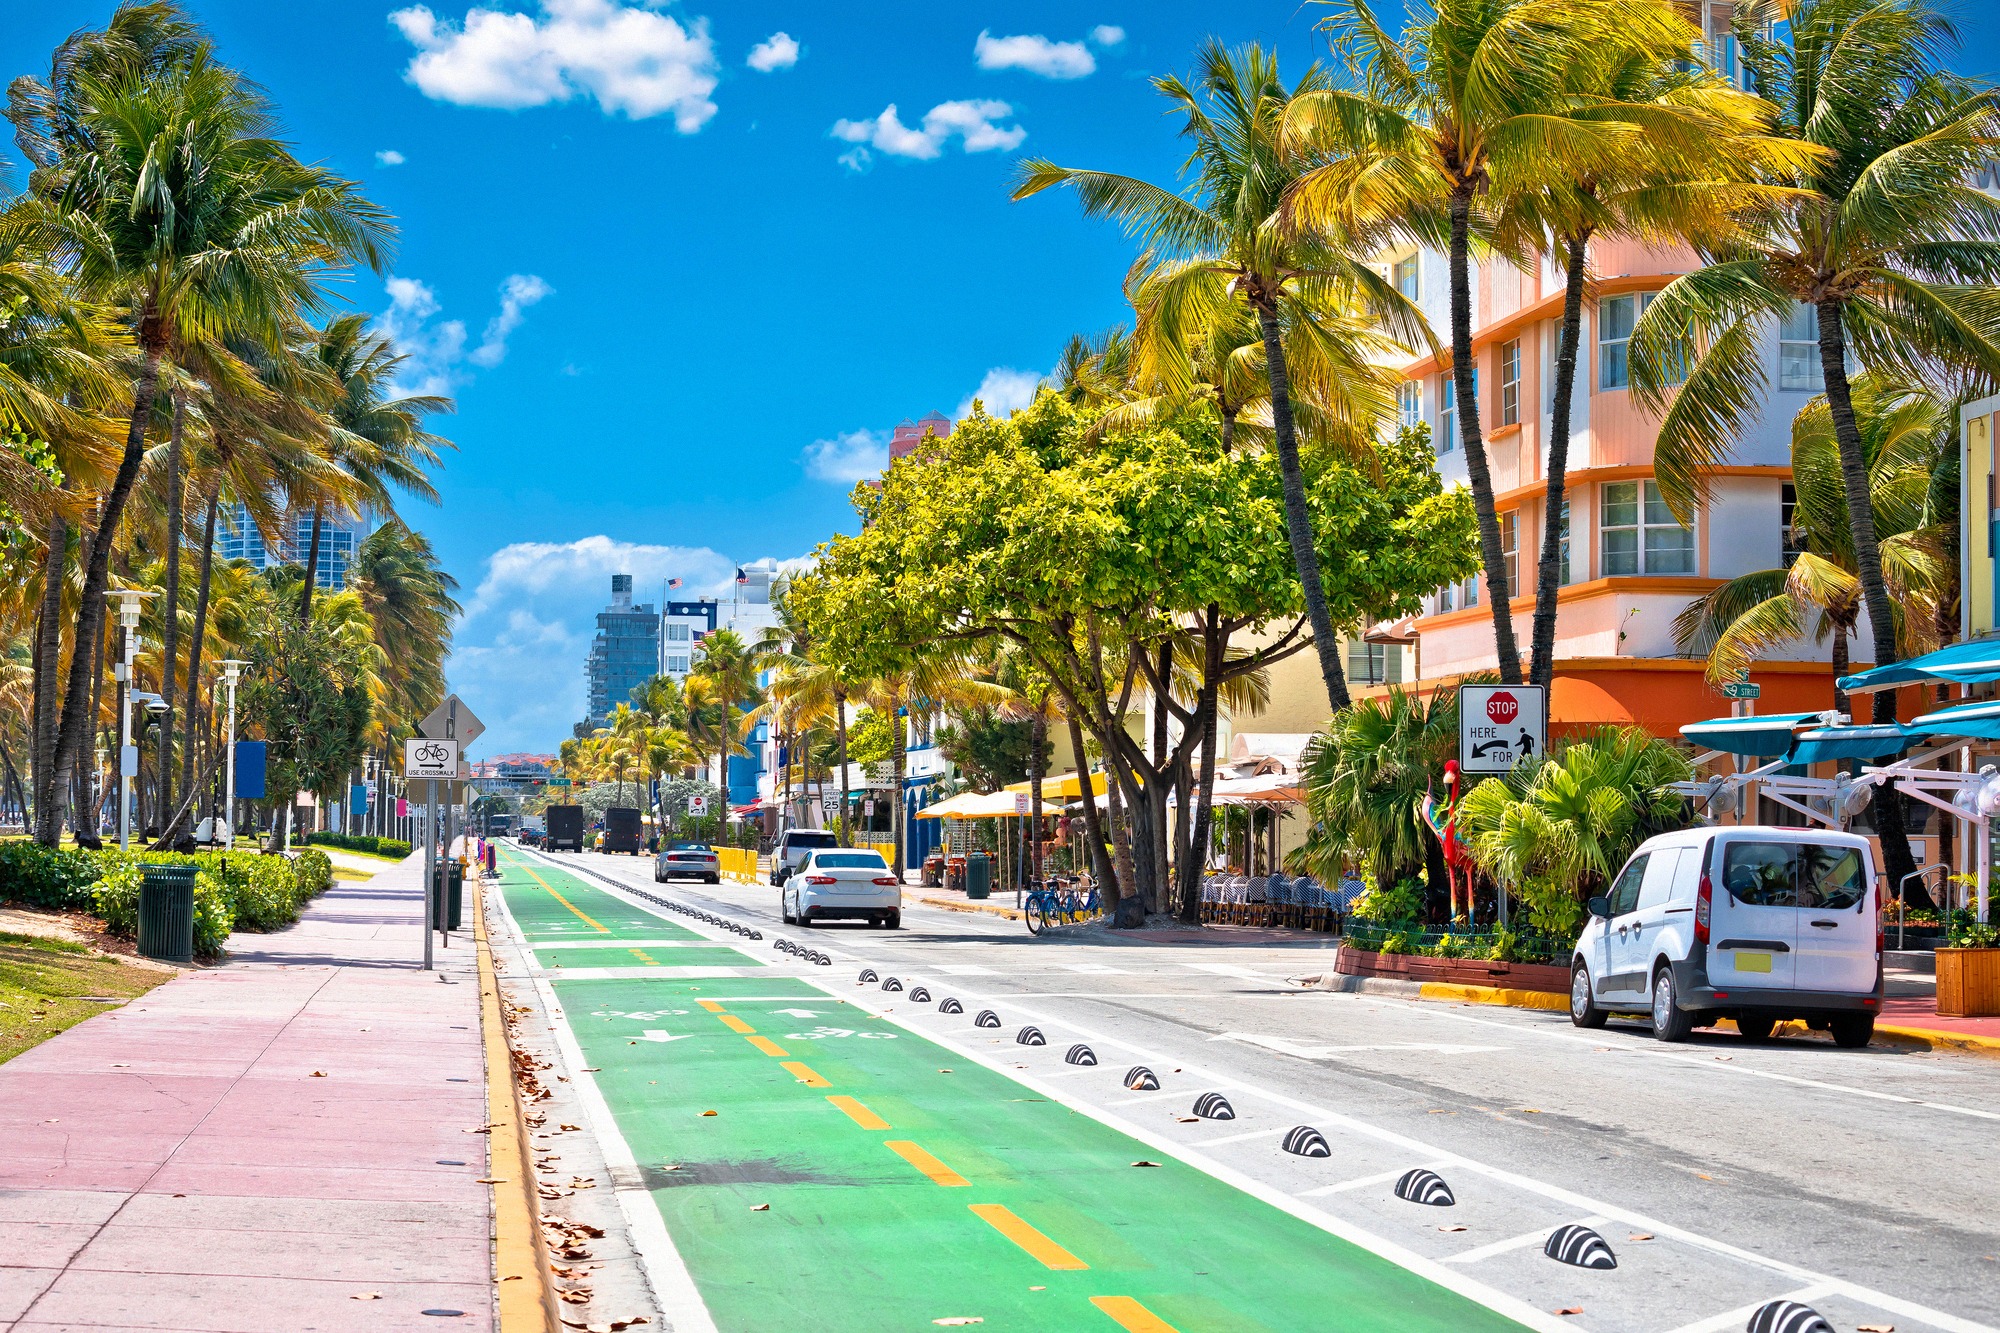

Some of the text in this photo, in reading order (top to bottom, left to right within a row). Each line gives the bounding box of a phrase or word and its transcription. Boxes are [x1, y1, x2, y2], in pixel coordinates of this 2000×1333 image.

[1741, 688, 1758, 696] STREET
[1488, 702, 1517, 714] STOP
[1470, 727, 1497, 738] HERE
[1492, 751, 1513, 762] FOR
[824, 801, 839, 809] 25
